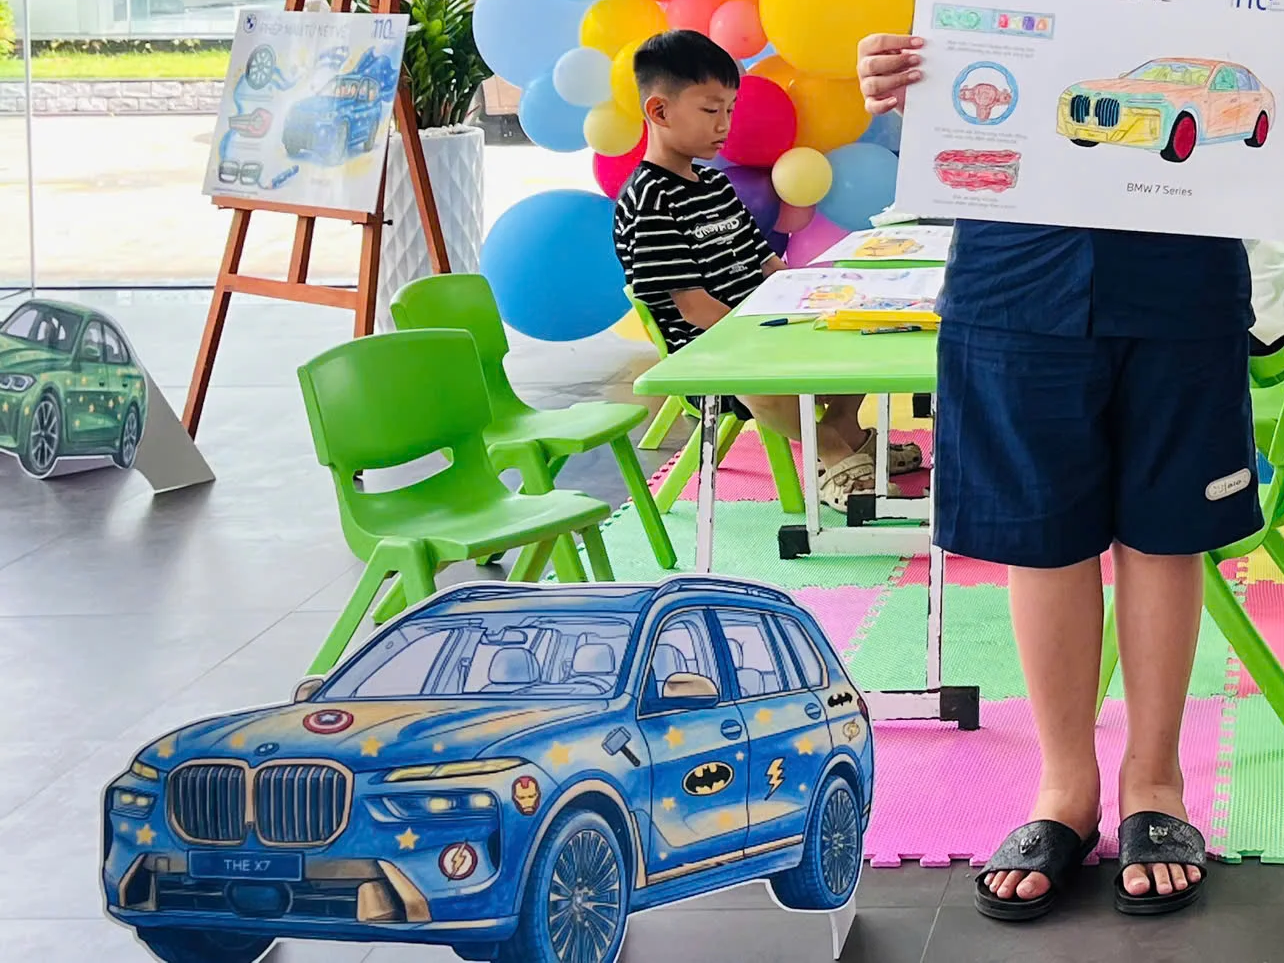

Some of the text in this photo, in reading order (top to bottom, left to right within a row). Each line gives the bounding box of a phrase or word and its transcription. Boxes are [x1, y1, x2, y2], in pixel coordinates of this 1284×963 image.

[1126, 182, 1193, 197] BMW 7 Series
[223, 858, 271, 872] THE X7
